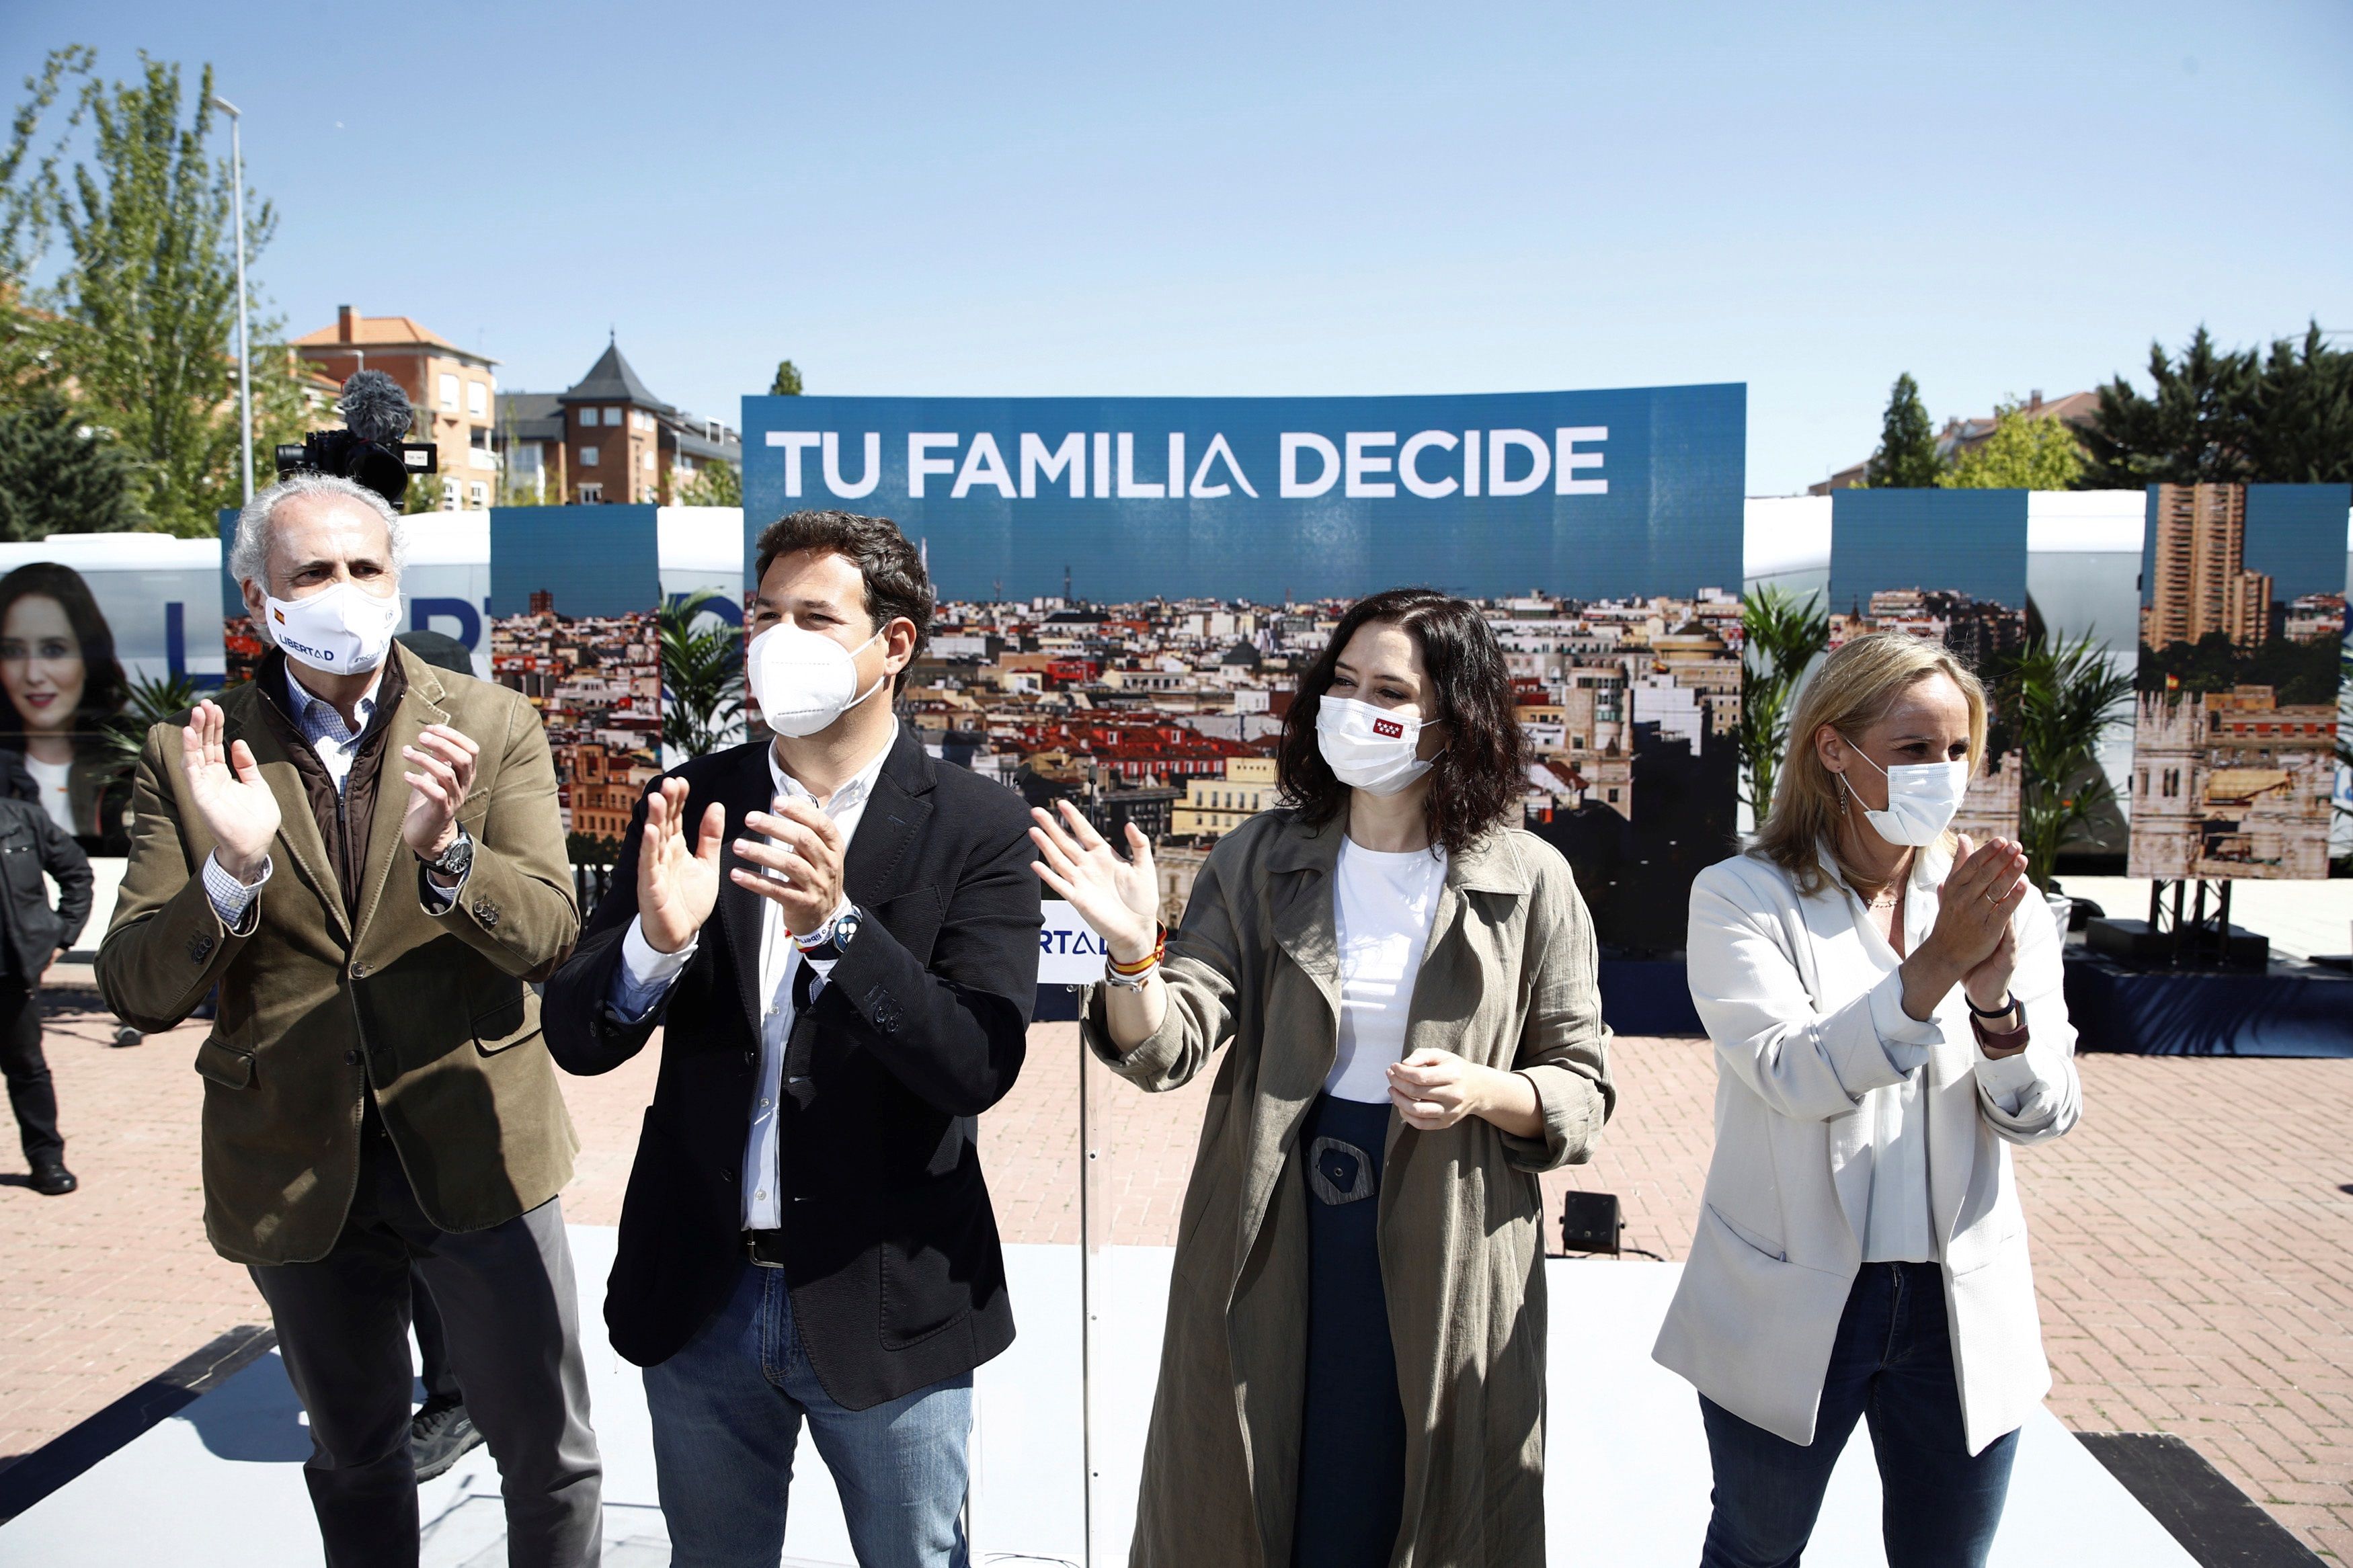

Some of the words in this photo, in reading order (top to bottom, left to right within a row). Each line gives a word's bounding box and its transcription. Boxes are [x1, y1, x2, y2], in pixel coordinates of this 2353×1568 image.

[765, 431, 880, 499] TU
[908, 432, 1259, 498] FAMILIA
[1280, 426, 1608, 498] DECIDE
[279, 633, 334, 661] LIBERTAD
